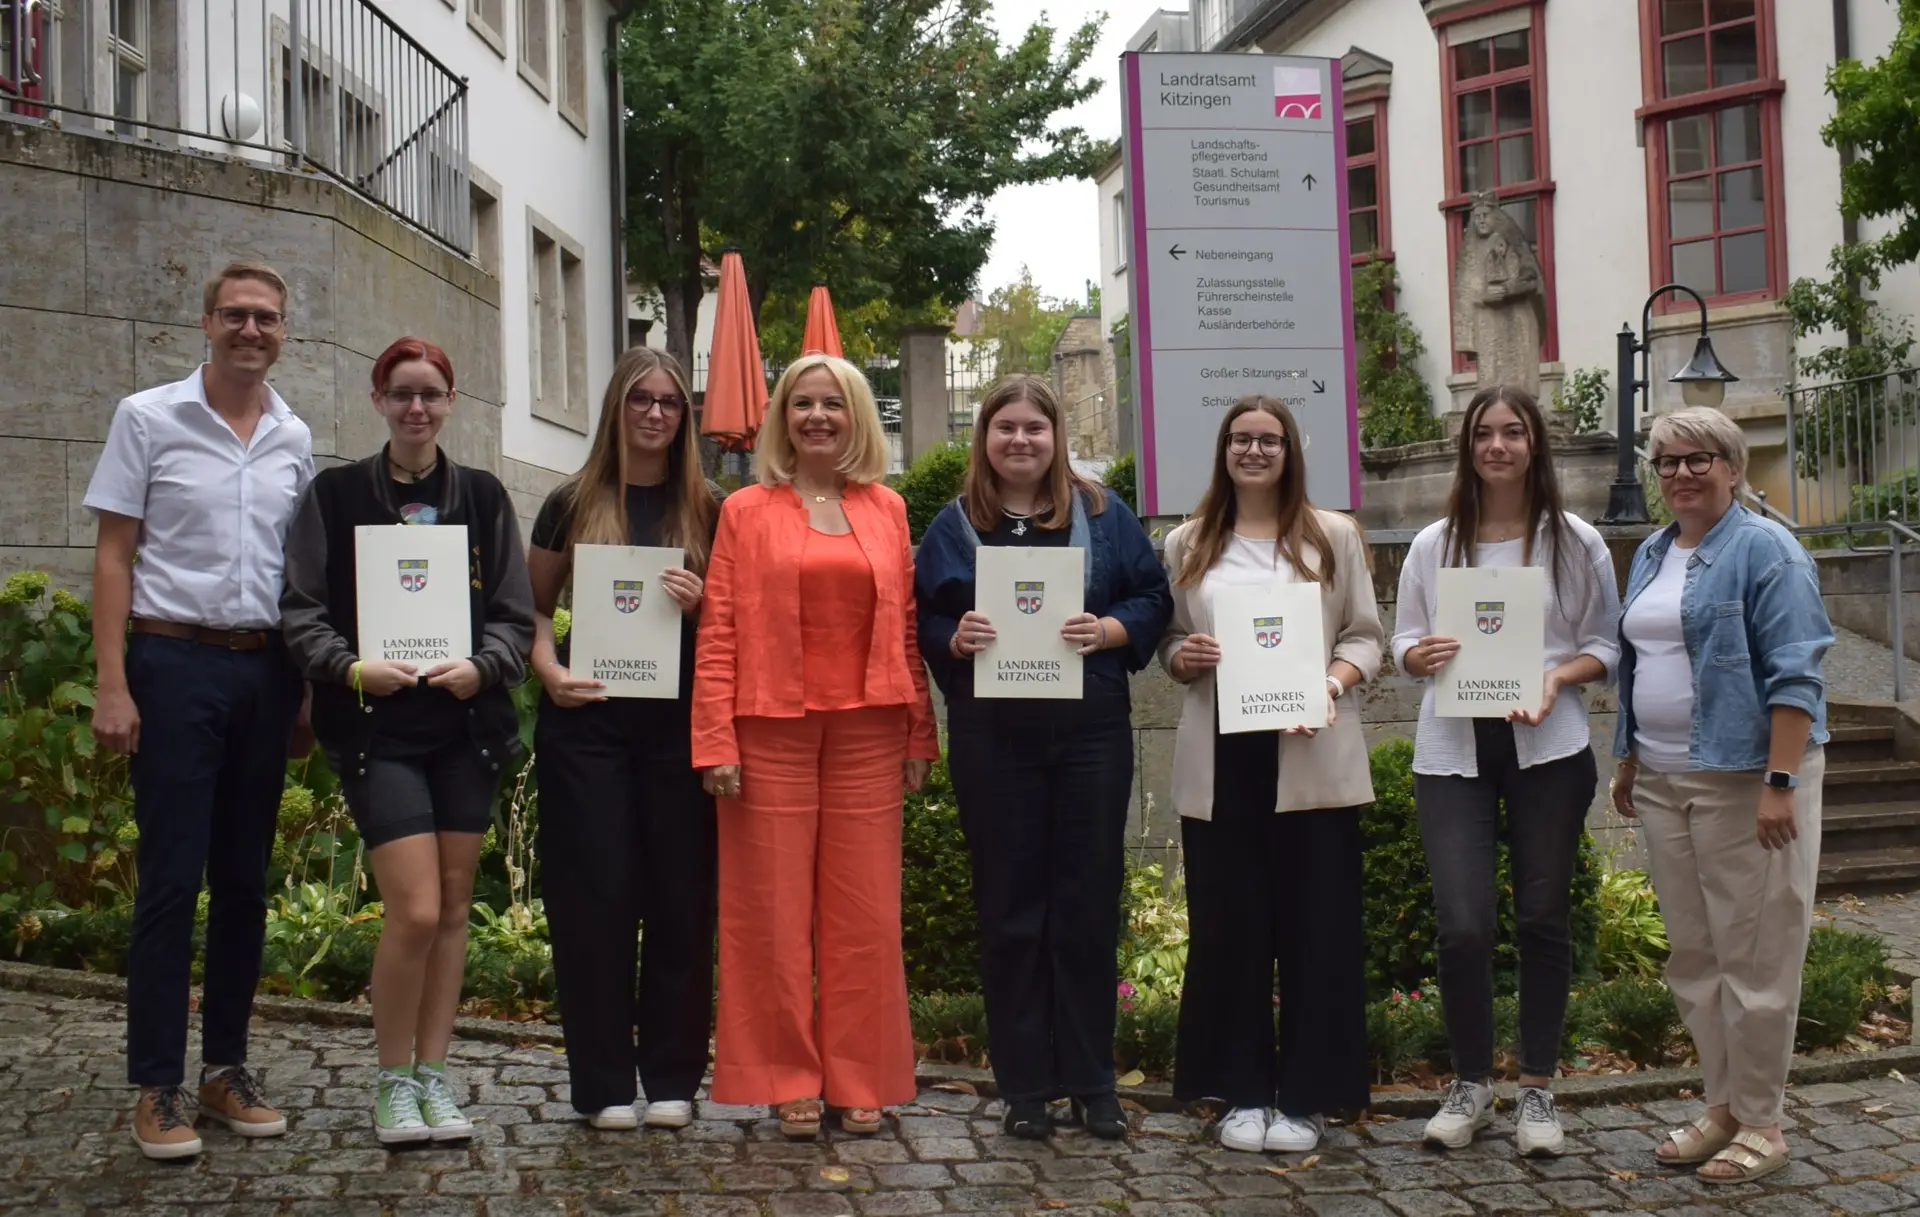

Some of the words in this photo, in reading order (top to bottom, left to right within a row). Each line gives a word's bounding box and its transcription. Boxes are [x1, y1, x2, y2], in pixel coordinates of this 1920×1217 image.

[1160, 72, 1256, 87] Landratsamt
[1160, 92, 1231, 109] Kitzingen
[1191, 139, 1260, 150] Landschafts-
[1191, 151, 1268, 163] pflegeverband
[1192, 168, 1227, 178] Staatl.
[1230, 168, 1279, 178] Schulamt
[1193, 182, 1280, 193] Gesundheitsamt
[1194, 196, 1250, 206] Tourismus
[1195, 250, 1274, 262] Nebeneingang
[1196, 277, 1286, 290] Zulassungsstelle
[1197, 291, 1294, 302] Führerscheinstelle
[1197, 306, 1232, 316] Kasse
[1198, 319, 1295, 330] Ausländerbehörde
[1200, 368, 1239, 378] Großer
[383, 638, 449, 649] LANDKREIS
[383, 649, 449, 660] KITZINGEN
[593, 659, 658, 670] LANDKREIS
[997, 660, 1061, 671] LANDKREIS
[593, 669, 658, 681] KITZINGEN
[997, 671, 1061, 682] KITZINGEN
[1458, 679, 1521, 690] LANDKREIS
[1241, 691, 1305, 704] LANDKREIS
[1457, 690, 1521, 701] KITZINGEN
[1241, 702, 1306, 715] KITZINGEN
